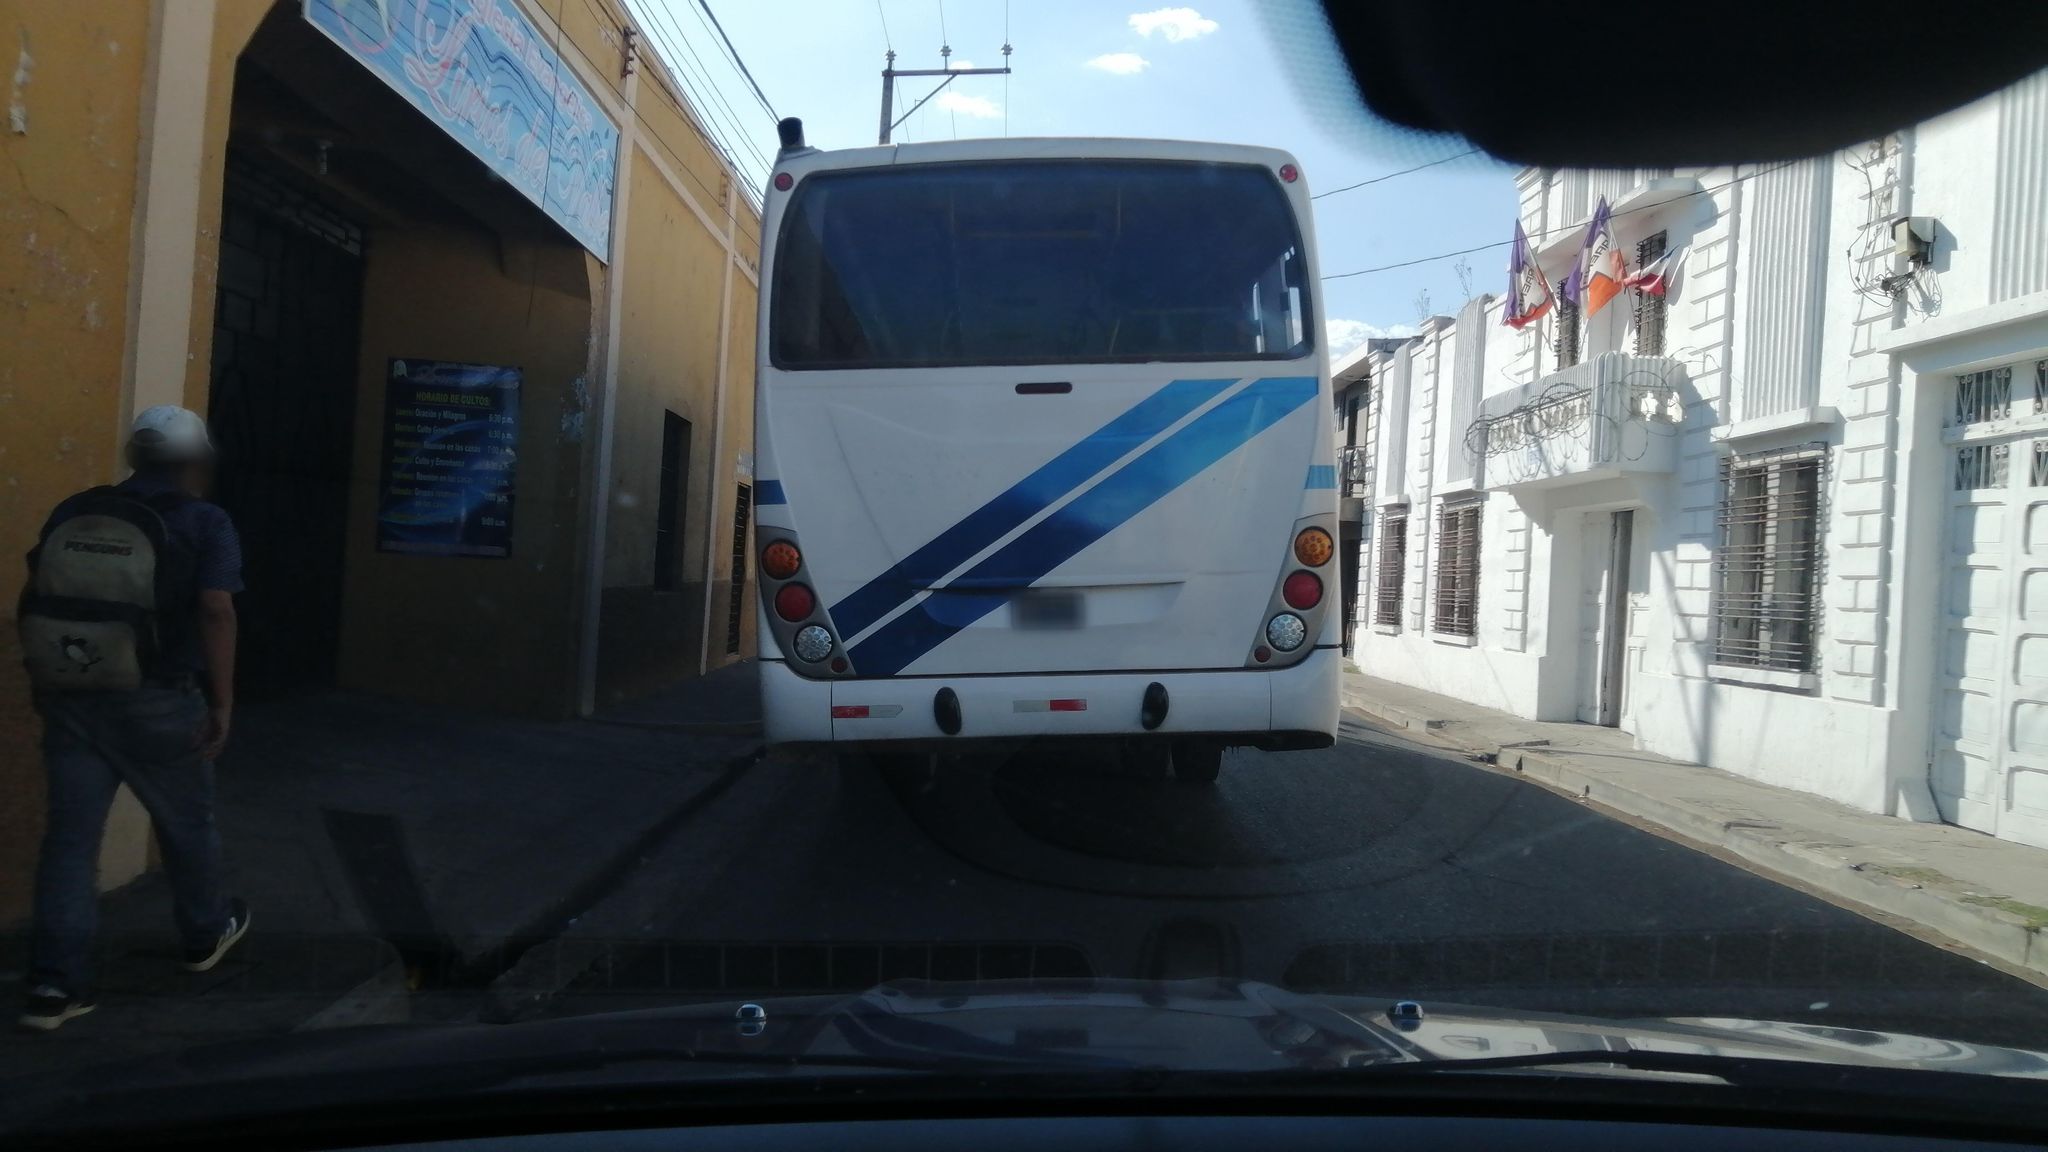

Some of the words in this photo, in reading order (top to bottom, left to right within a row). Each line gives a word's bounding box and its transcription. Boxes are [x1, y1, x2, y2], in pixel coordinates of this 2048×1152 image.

[415, 391, 448, 402] HORARIO
[450, 393, 460, 404] DE
[63, 540, 132, 556] PENGUINS
